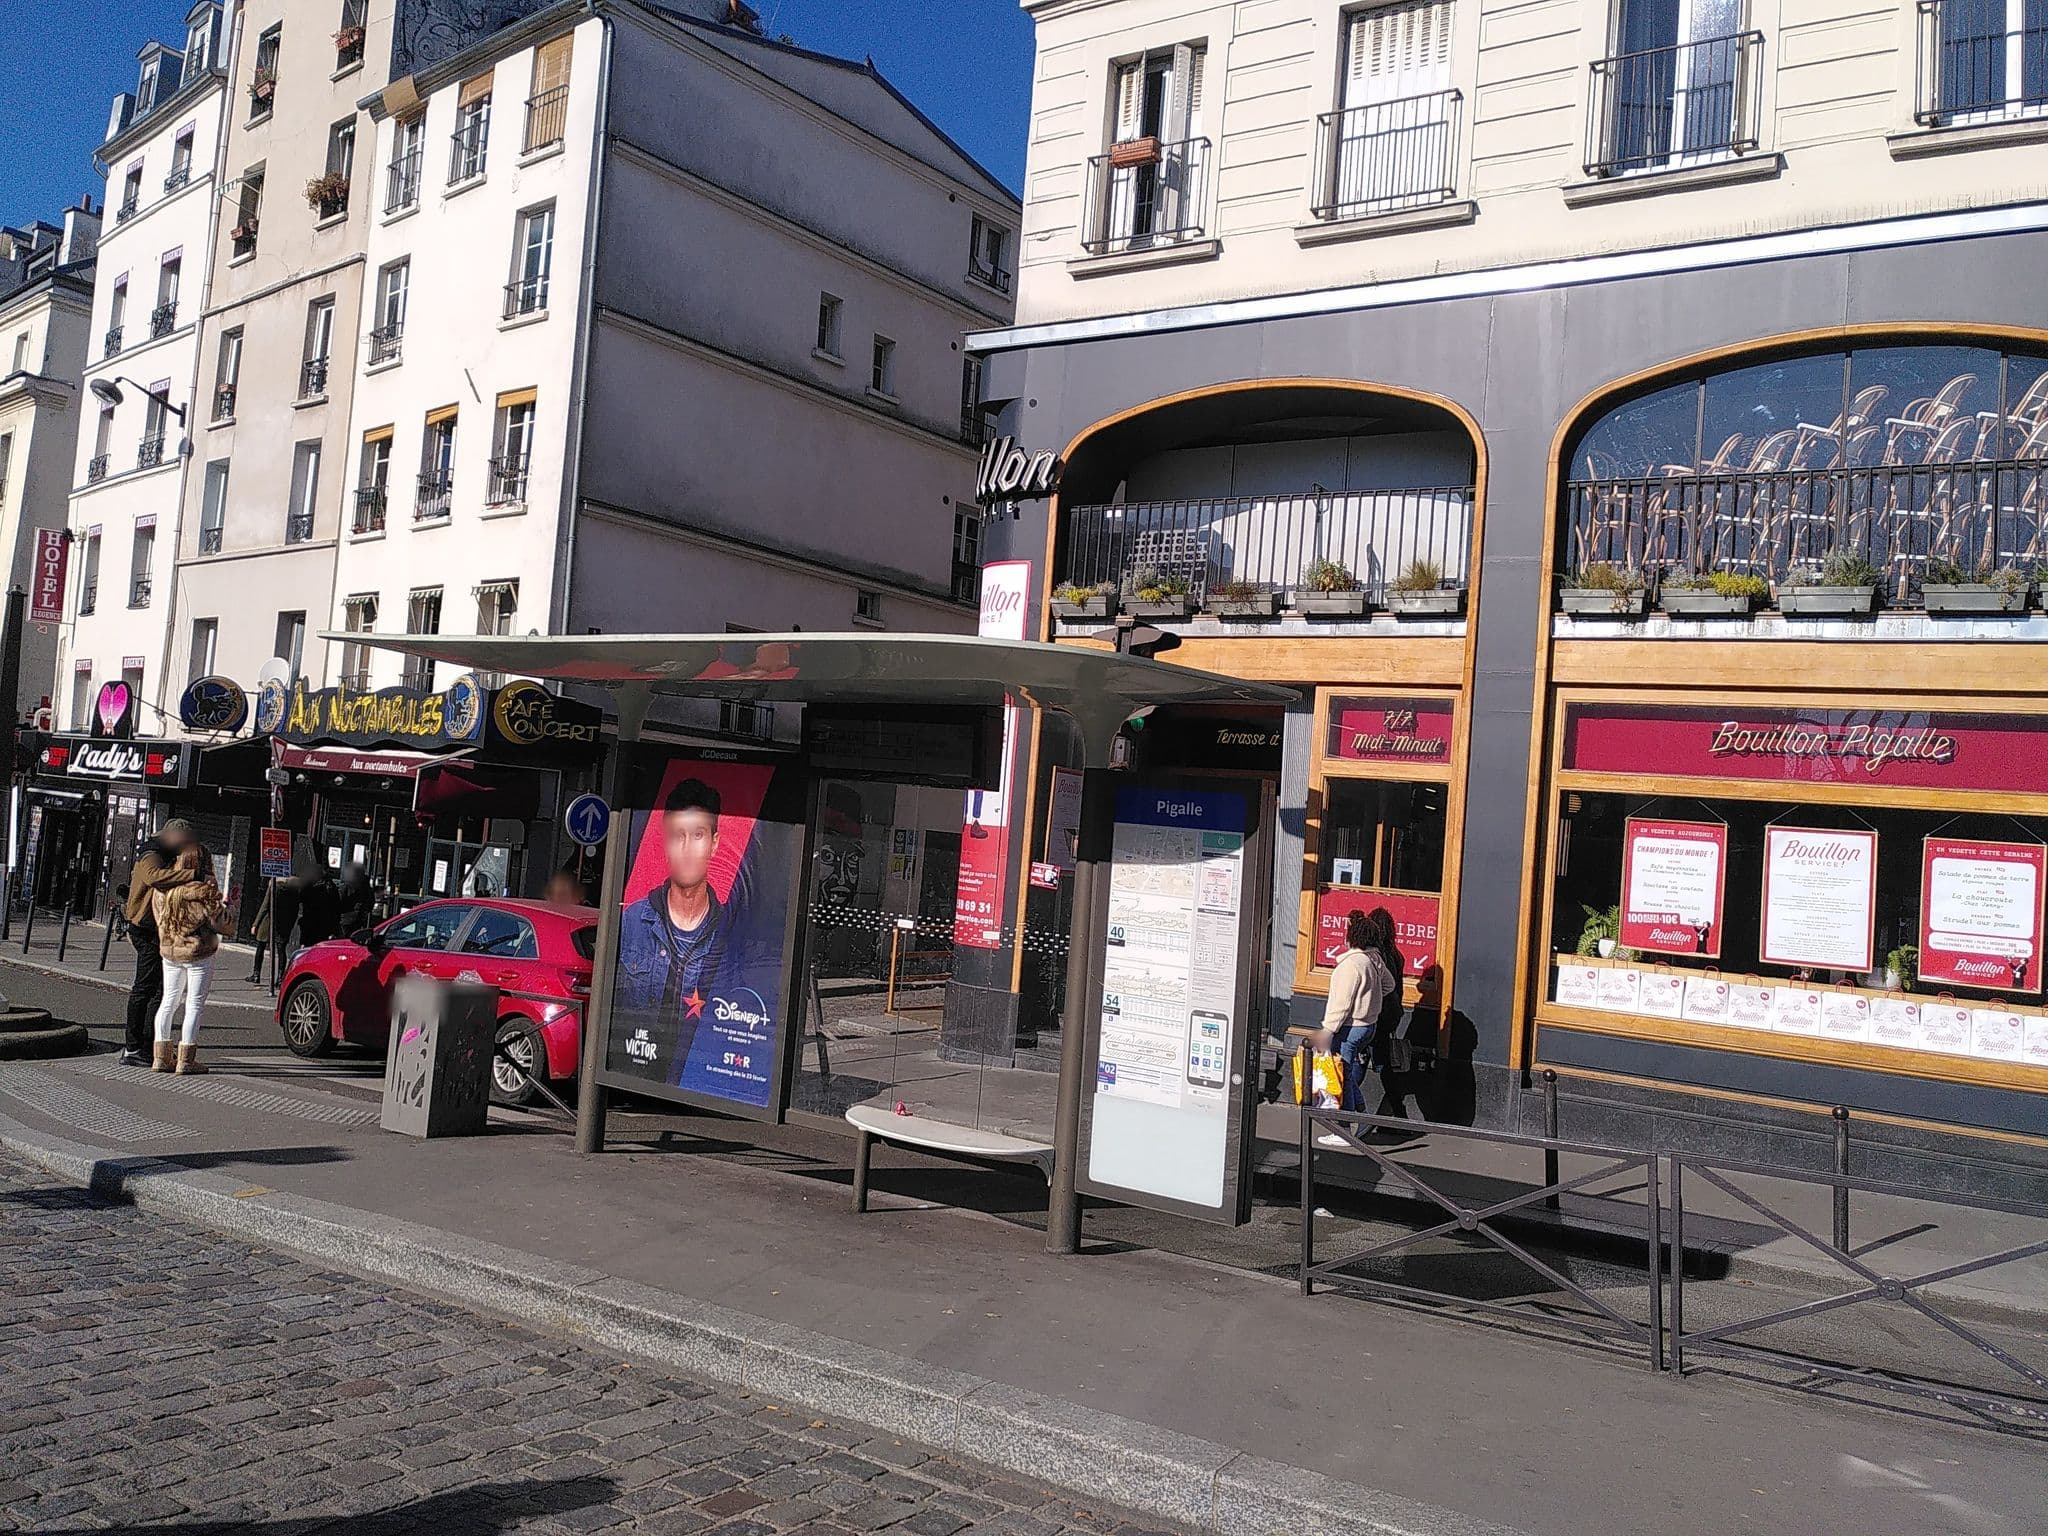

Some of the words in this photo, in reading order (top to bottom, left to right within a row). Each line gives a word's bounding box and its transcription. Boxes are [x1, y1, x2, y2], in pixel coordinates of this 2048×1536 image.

[41, 531, 62, 609] HOTEL
[326, 681, 444, 736] NOCTAMBULES
[1382, 709, 1414, 727] 7/7
[1216, 728, 1266, 746] Terrasse
[1350, 732, 1442, 753] Midi-Minuit
[700, 749, 738, 760] JCDecaux
[1709, 721, 1829, 754] Bouillon
[1842, 724, 1952, 772] Pigalle
[67, 742, 143, 779] Lady's
[365, 759, 408, 774] noctambules
[1157, 800, 1203, 817] Pigalle
[1637, 845, 1674, 856] CHAMPIONS
[1674, 848, 1684, 856] DU
[1684, 850, 1708, 858] MONDE
[1780, 840, 1861, 862] Bouillon
[1948, 847, 1976, 855] VEDETTE
[1979, 849, 2001, 857] CETTE
[965, 901, 976, 911] 69
[978, 902, 991, 913] 31
[1965, 893, 2014, 904] choucroute
[1110, 926, 1125, 939] 40
[1322, 914, 1350, 930] ENT
[1395, 921, 1437, 940] IBRE
[1649, 928, 1692, 943] Bouillon
[1953, 958, 2005, 975] Bouillon
[1105, 994, 1120, 1007] 54
[712, 997, 771, 1031] Disney+
[1875, 1025, 1911, 1037] Bouillon
[625, 1038, 657, 1061] VICTOR
[1978, 1037, 2015, 1051] Bouillon
